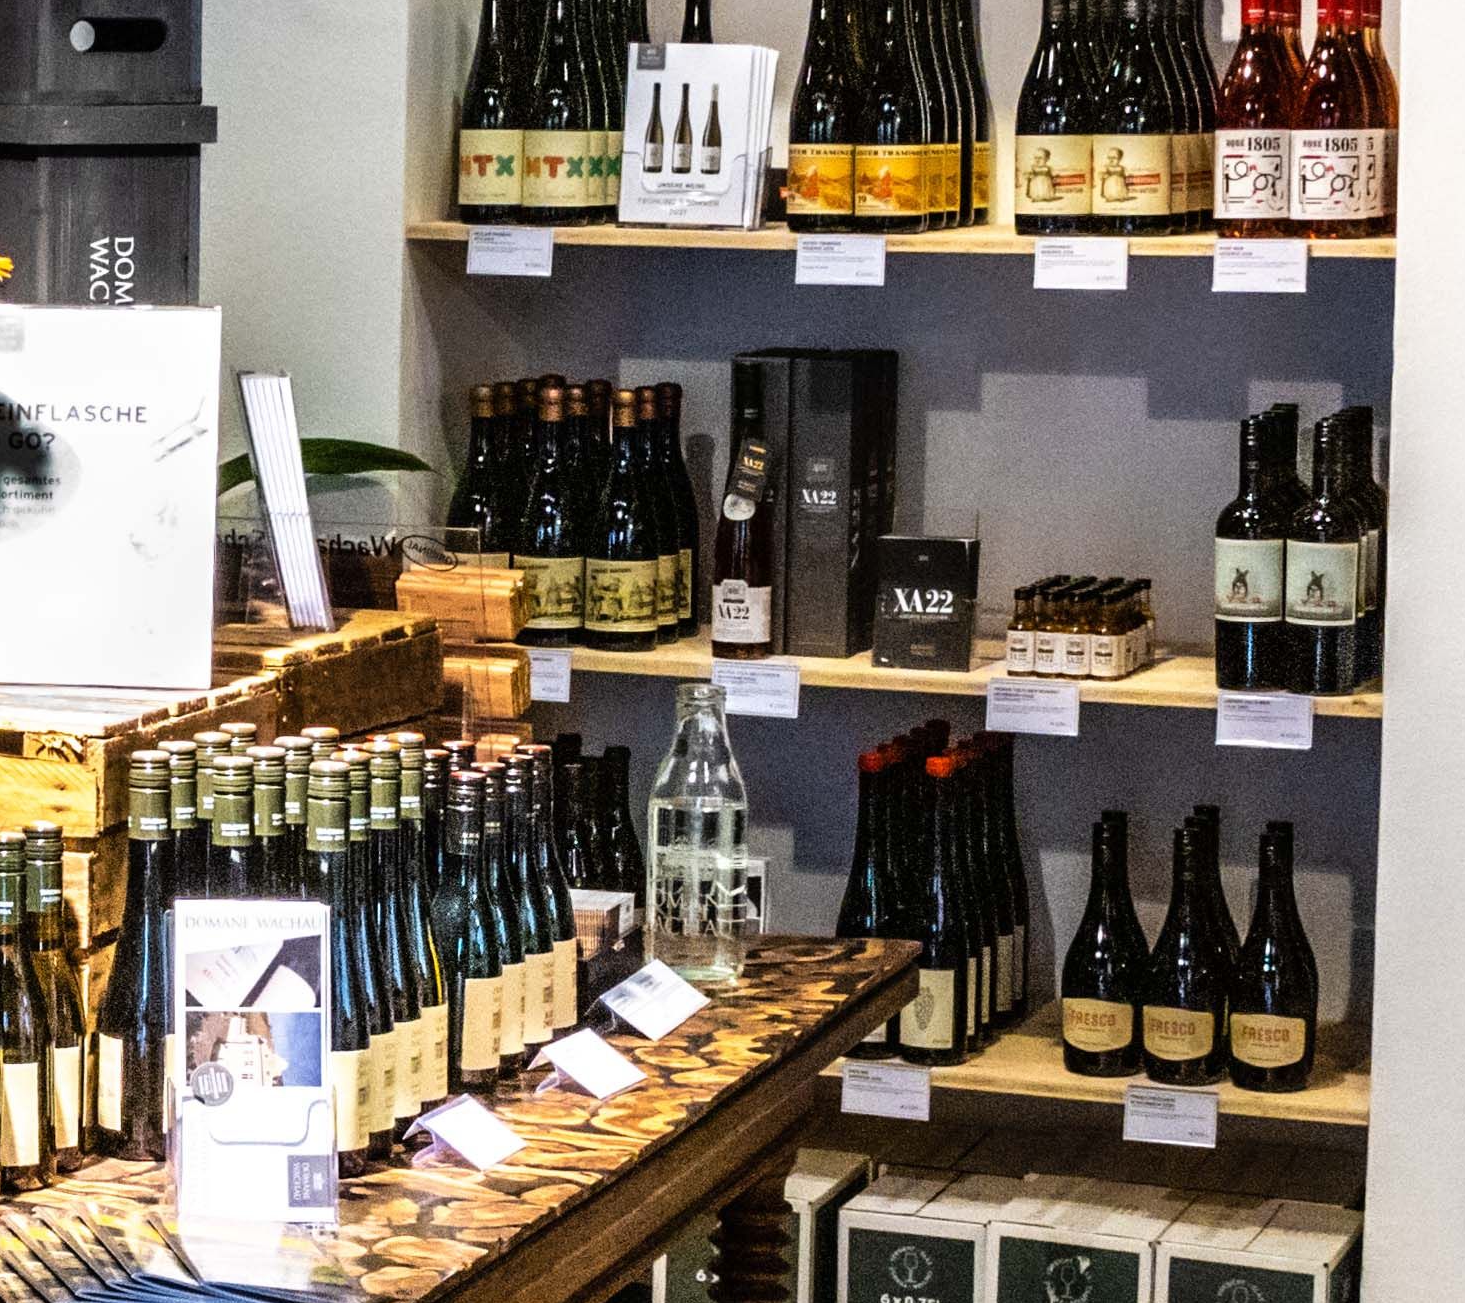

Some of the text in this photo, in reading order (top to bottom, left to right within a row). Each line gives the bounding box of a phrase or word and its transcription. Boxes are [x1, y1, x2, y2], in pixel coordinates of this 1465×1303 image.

[1247, 136, 1282, 152] 1805
[1324, 136, 1360, 152] 1805
[89, 236, 111, 305] WAC
[114, 236, 135, 305] DOM
[8, 431, 56, 450] GO?
[3, 475, 61, 487] gesamtes
[801, 488, 837, 506] XA22
[892, 588, 954, 614] XA22
[717, 604, 751, 620] XA22
[257, 914, 321, 930] WACHAU
[1069, 1009, 1116, 1027] FRESCO
[1148, 1017, 1196, 1036] FRESCO
[1241, 1025, 1291, 1042] FRESCO
